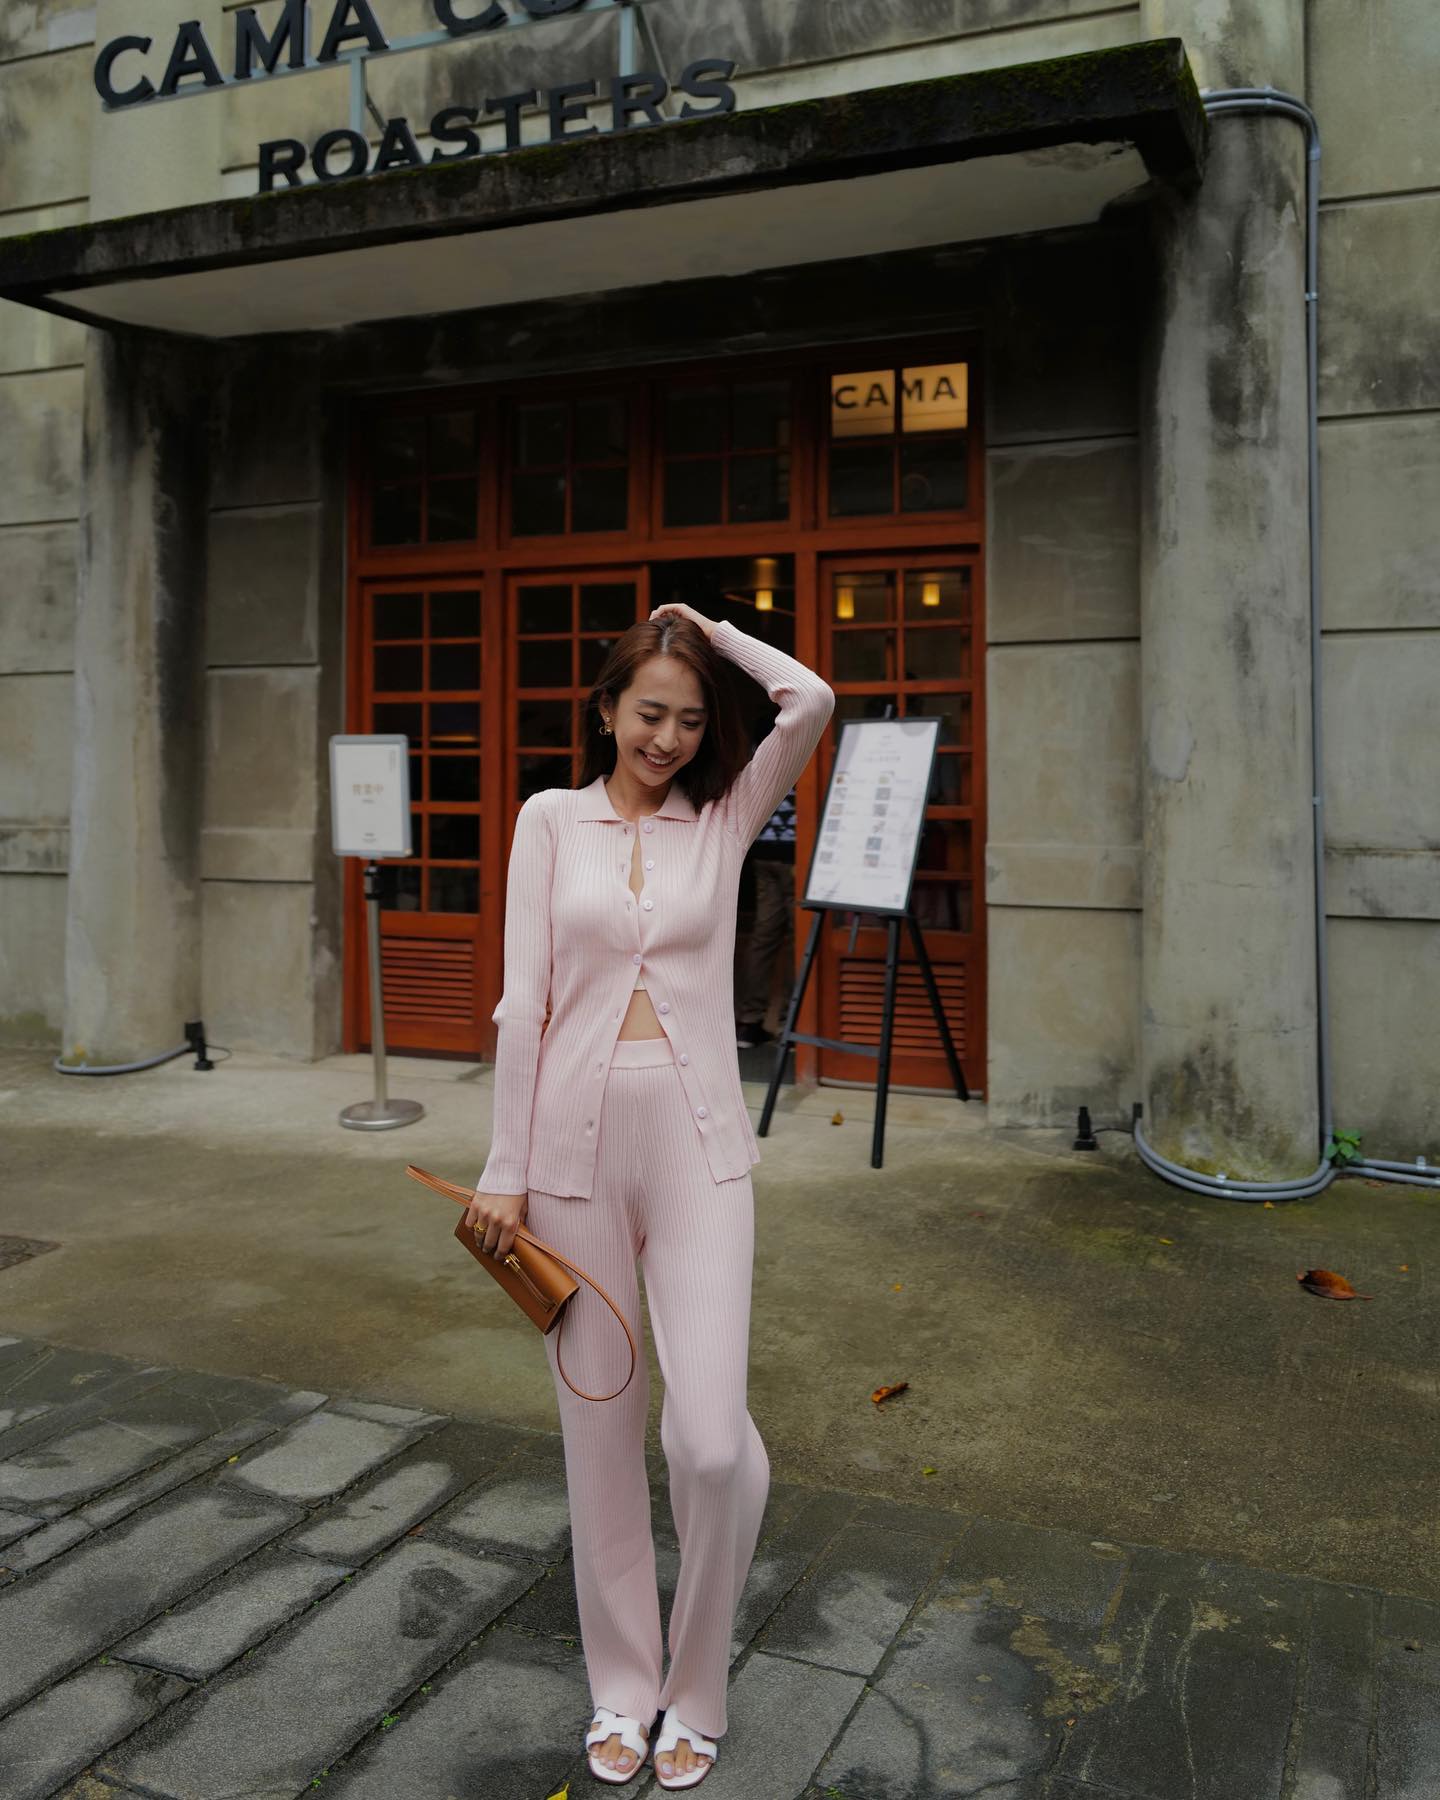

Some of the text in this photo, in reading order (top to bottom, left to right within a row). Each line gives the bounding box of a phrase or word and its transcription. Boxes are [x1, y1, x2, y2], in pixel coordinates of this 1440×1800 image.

[95, 0, 389, 107] CAMA
[259, 58, 738, 192] ROASTERS
[834, 376, 957, 409] CAMA
